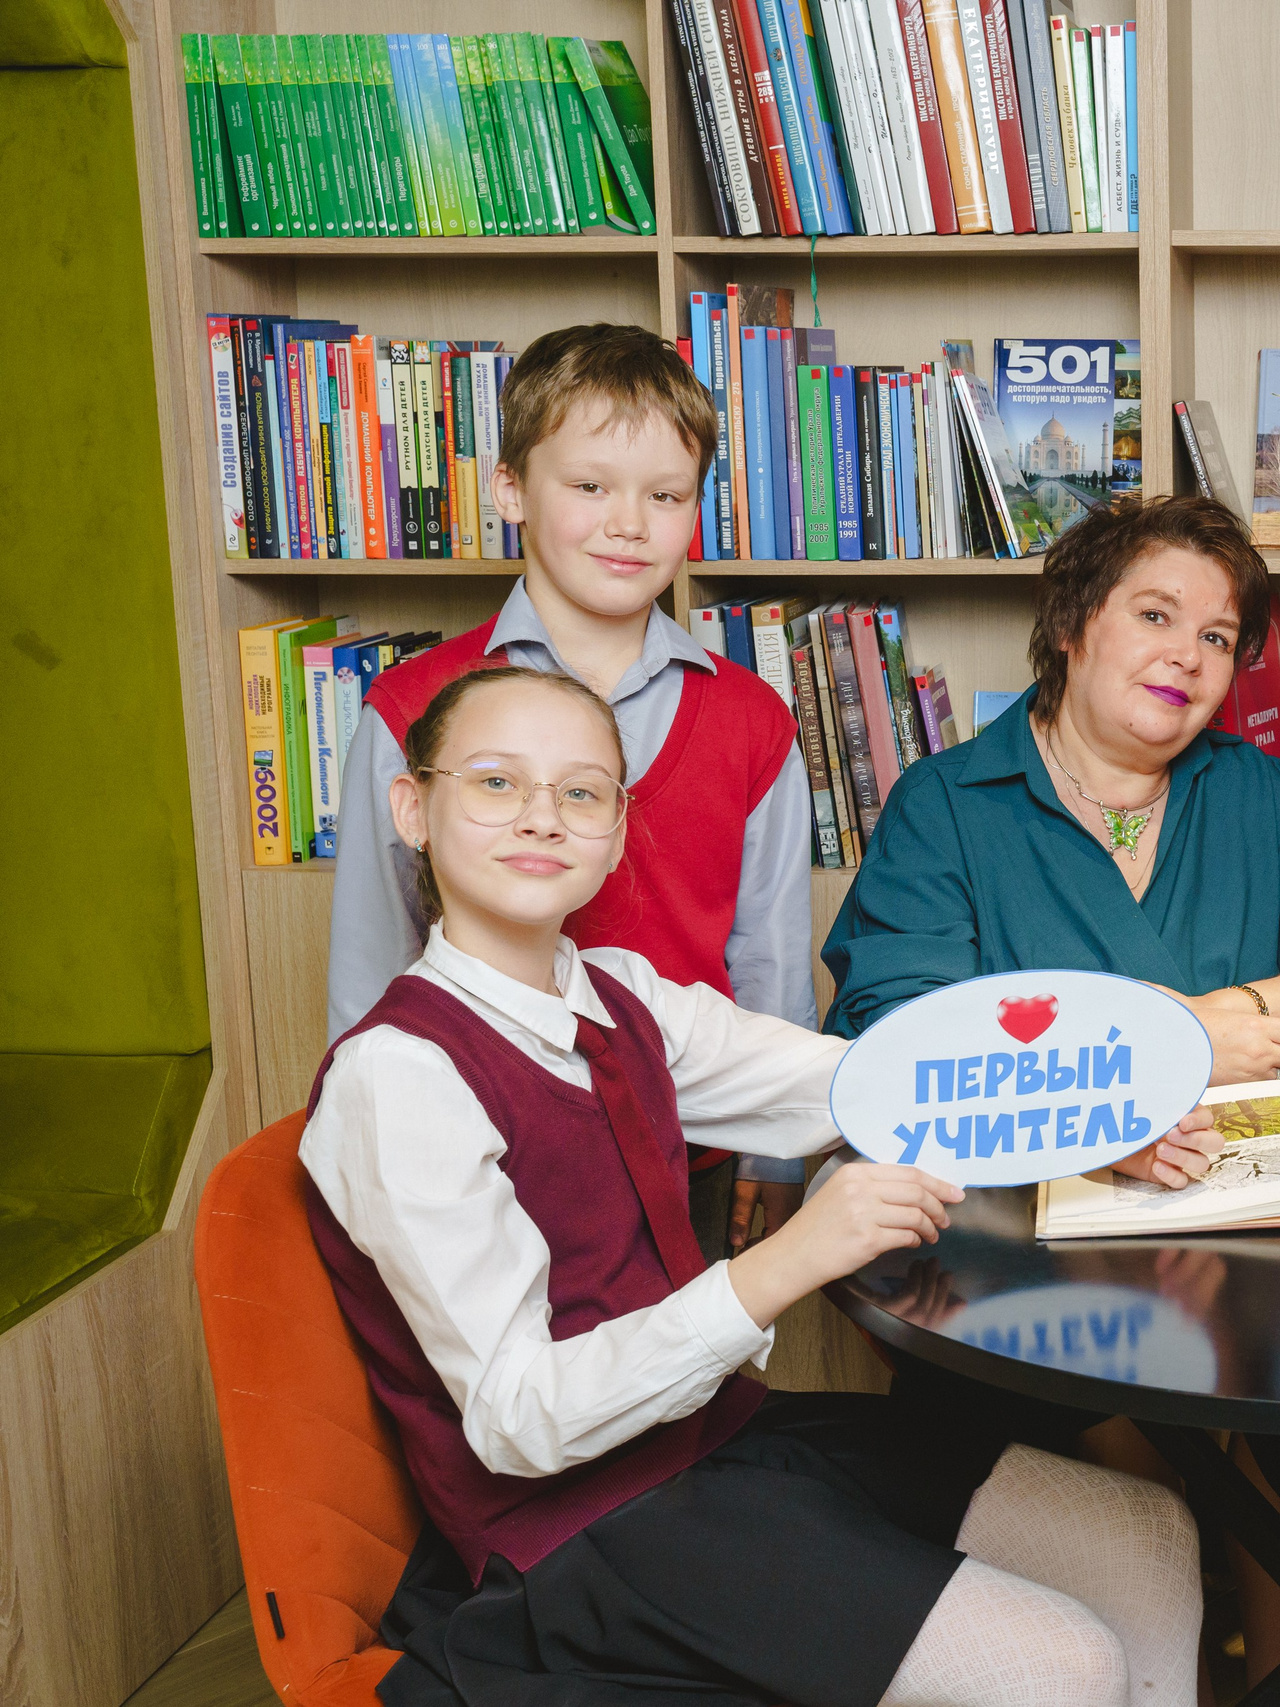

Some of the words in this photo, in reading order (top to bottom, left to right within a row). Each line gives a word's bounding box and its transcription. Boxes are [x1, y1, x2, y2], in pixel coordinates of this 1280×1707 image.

[720, 9, 733, 39] УРАЛА
[728, 43, 739, 74] ЛЕСАХ
[904, 15, 922, 80] ЕКАТЕРИНБУРГА
[985, 13, 1002, 78] ЕКАТЕРИНБУРГА
[705, 50, 730, 120] НИЖНЕЙ
[736, 90, 747, 114] УГРЫ
[776, 66, 794, 102] РОССИЯ
[915, 81, 928, 122] ПИСАТЕЛИ
[996, 79, 1007, 120] ПИСАТЕЛИ
[1061, 85, 1070, 113] банка
[1041, 87, 1051, 123] ОБЛАСТЬ
[1065, 116, 1072, 126] из
[742, 118, 759, 162] ДРЕВНИЕ
[1046, 125, 1059, 186] СВЕРДЛОВСКАЯ
[1066, 127, 1076, 168] Человек
[237, 155, 250, 202] Рефрейминг
[245, 154, 259, 201] организаций
[393, 157, 407, 201] Переговоры
[473, 153, 487, 198] Платформа
[619, 165, 631, 184] Toyota
[723, 124, 752, 223] СОКРОВИЩА
[775, 154, 785, 179] ГОРОДЕ
[963, 167, 972, 189] ГОРОД
[627, 185, 638, 197] Дао
[1115, 181, 1123, 212] АСБЕСТ.
[712, 320, 724, 390] Первоуральск
[1006, 346, 1110, 384] 501
[217, 370, 231, 418] сайтов
[398, 381, 407, 409] ДЕТЕЙ
[420, 380, 429, 407] ДЕТЕЙ
[482, 363, 490, 405] ДОМАШНИЙ
[732, 382, 740, 395] 275
[1008, 386, 1111, 395] достопримечательность,
[1013, 395, 1048, 404] которую
[1050, 395, 1070, 404] надо
[1073, 395, 1106, 404] увидеть
[255, 392, 264, 424] БОЛЬШАЯ
[291, 378, 302, 439] КОМПЬЮТЕРА
[806, 409, 815, 431] Урала
[834, 395, 843, 446] ПРЕДДВЕРИИ
[257, 426, 265, 446] КНИГА
[360, 411, 372, 463] ДОМАШНИЙ
[484, 407, 492, 450] КОМПЬЮТЕР
[733, 405, 744, 470] ПЕРВОУРАЛЬСКУ
[218, 424, 237, 488] Создание
[240, 412, 248, 447] СЕКРЕТЫ
[247, 500, 255, 521] ФОТО
[296, 442, 305, 476] АЗБУКА
[322, 424, 331, 473] информации
[403, 435, 411, 470] PYTHON
[424, 432, 432, 471] SCRATCH
[718, 439, 727, 460] 1941
[863, 452, 872, 482] Сибирь:
[882, 450, 894, 470] УРАЛ
[845, 451, 853, 484] РОССИИ
[325, 476, 333, 505] личной
[365, 466, 375, 520] КОМПЬЮТЕР
[720, 481, 731, 518] ПАМЯТИ
[810, 464, 818, 515] Политическая
[817, 467, 827, 509] Уральского
[838, 476, 847, 514] СРЕДНИЙ
[845, 486, 855, 514] НОВОЙ
[865, 484, 874, 517] Западная
[261, 487, 272, 532] ФОТОГРАФИИ
[389, 497, 399, 547] Краудсорсинг
[809, 523, 829, 531] 1985
[839, 520, 857, 528] 1985
[722, 521, 732, 549] КНИГА
[809, 535, 829, 543] 2007
[798, 661, 813, 697] ГОРОД
[283, 683, 292, 735] ИНФОГРАФИКА
[806, 704, 814, 717] ЗА
[1247, 706, 1279, 727] МЕТАЛЛУРГИ
[808, 724, 823, 763] ОТВЕТЕ
[1255, 731, 1275, 746] УРАЛА
[255, 767, 279, 838] 2009
[915, 1025, 1132, 1104] ПЕРВЫЙ
[892, 1099, 1152, 1165] УЧИТЕЛЬ
